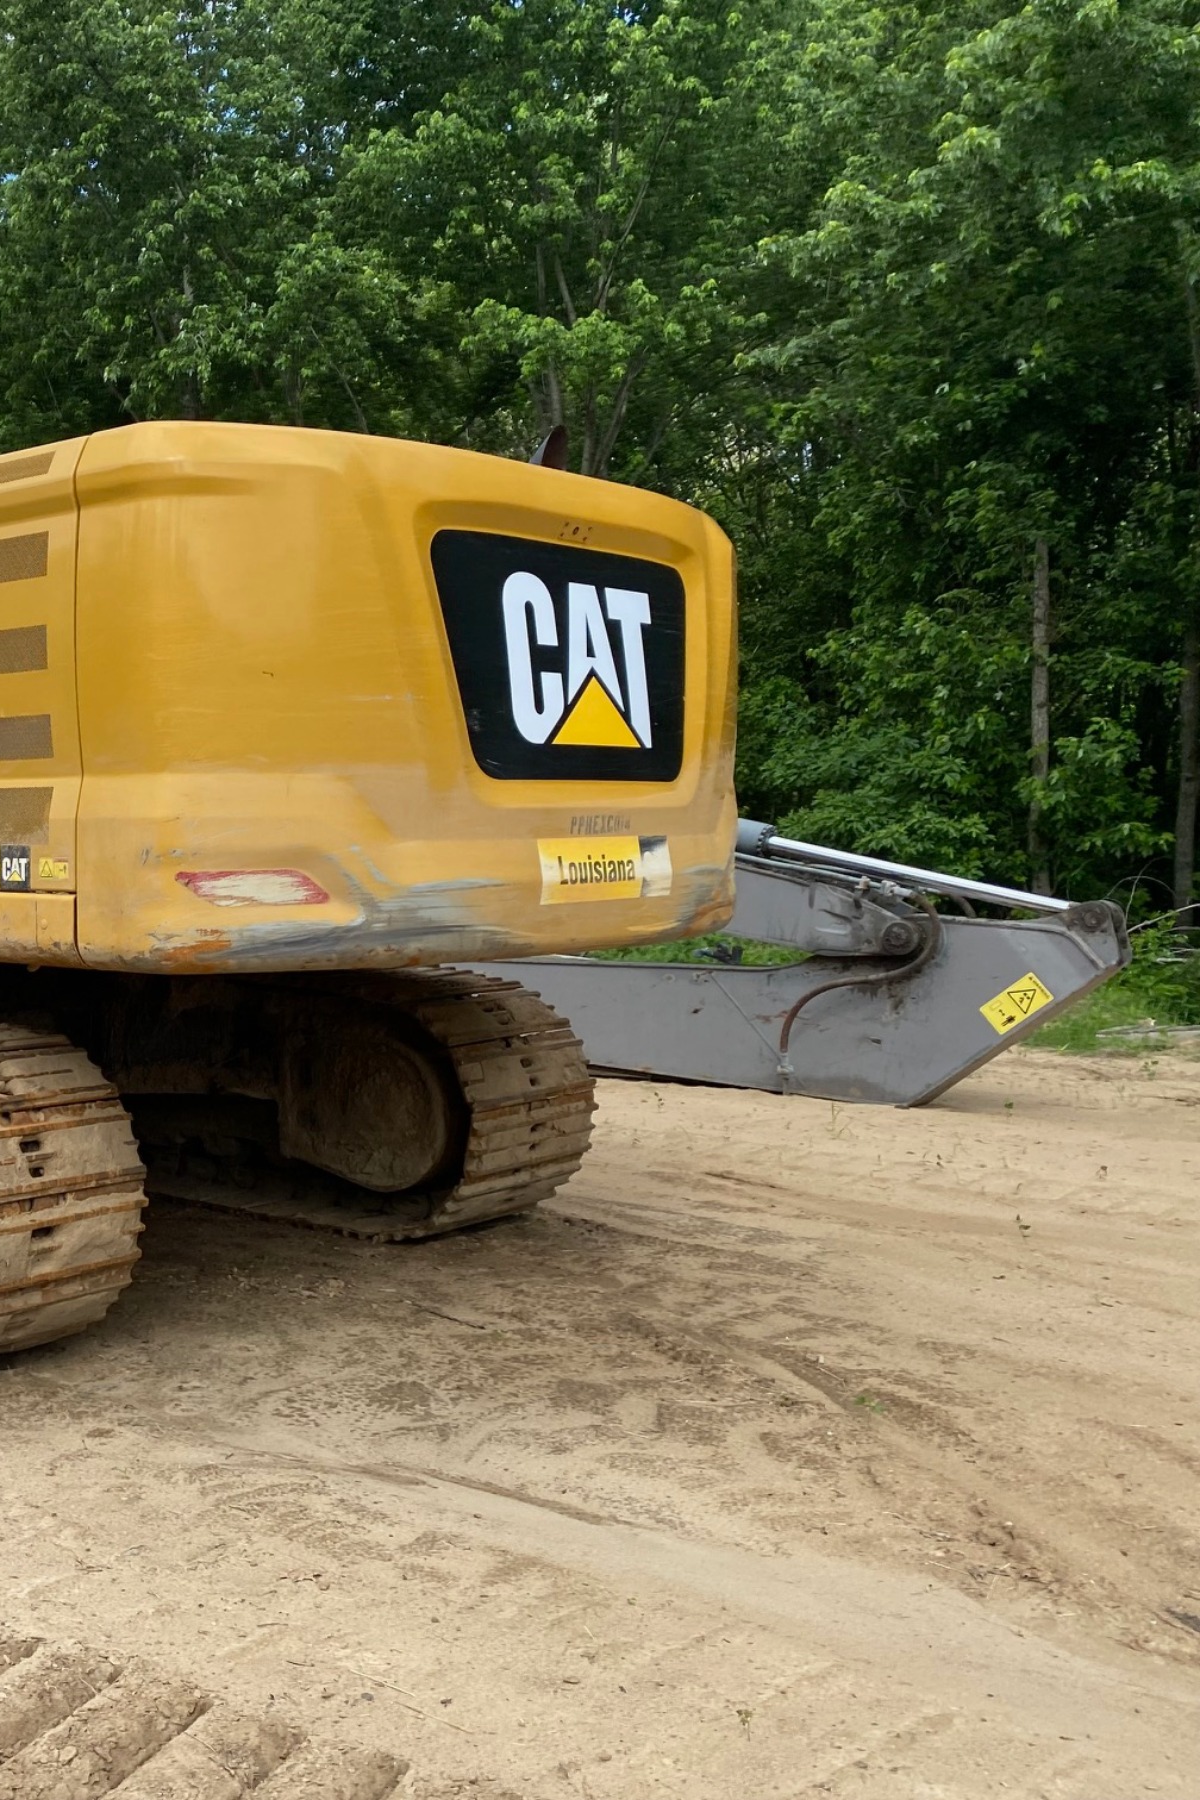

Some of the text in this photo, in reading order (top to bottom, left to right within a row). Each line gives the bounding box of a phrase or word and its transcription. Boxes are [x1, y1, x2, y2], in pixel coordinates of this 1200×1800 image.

[502, 571, 653, 749] CAT
[2, 857, 30, 882] CAT
[557, 854, 636, 885] Louisiana
